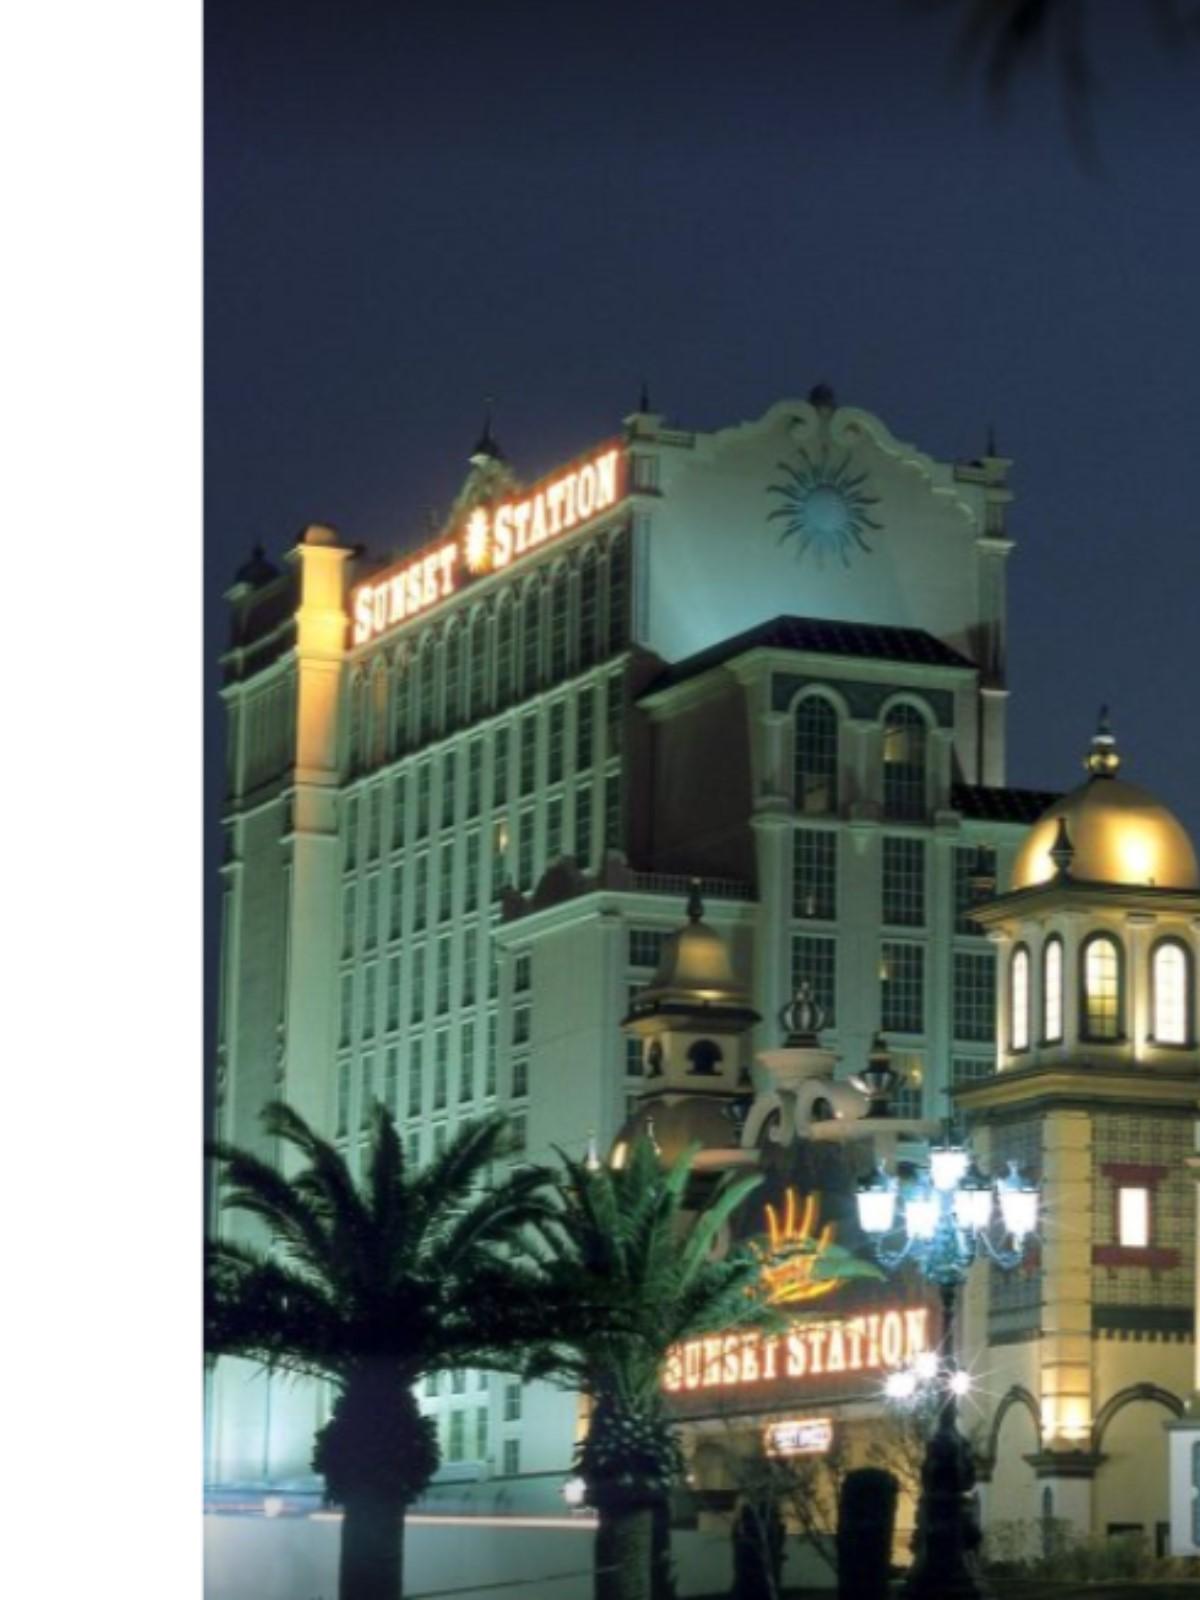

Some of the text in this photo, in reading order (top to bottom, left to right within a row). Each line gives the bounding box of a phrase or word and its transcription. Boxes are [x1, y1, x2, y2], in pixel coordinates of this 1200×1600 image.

[353, 448, 619, 646] SUNSET STATION
[786, 1307, 929, 1377] STATION
